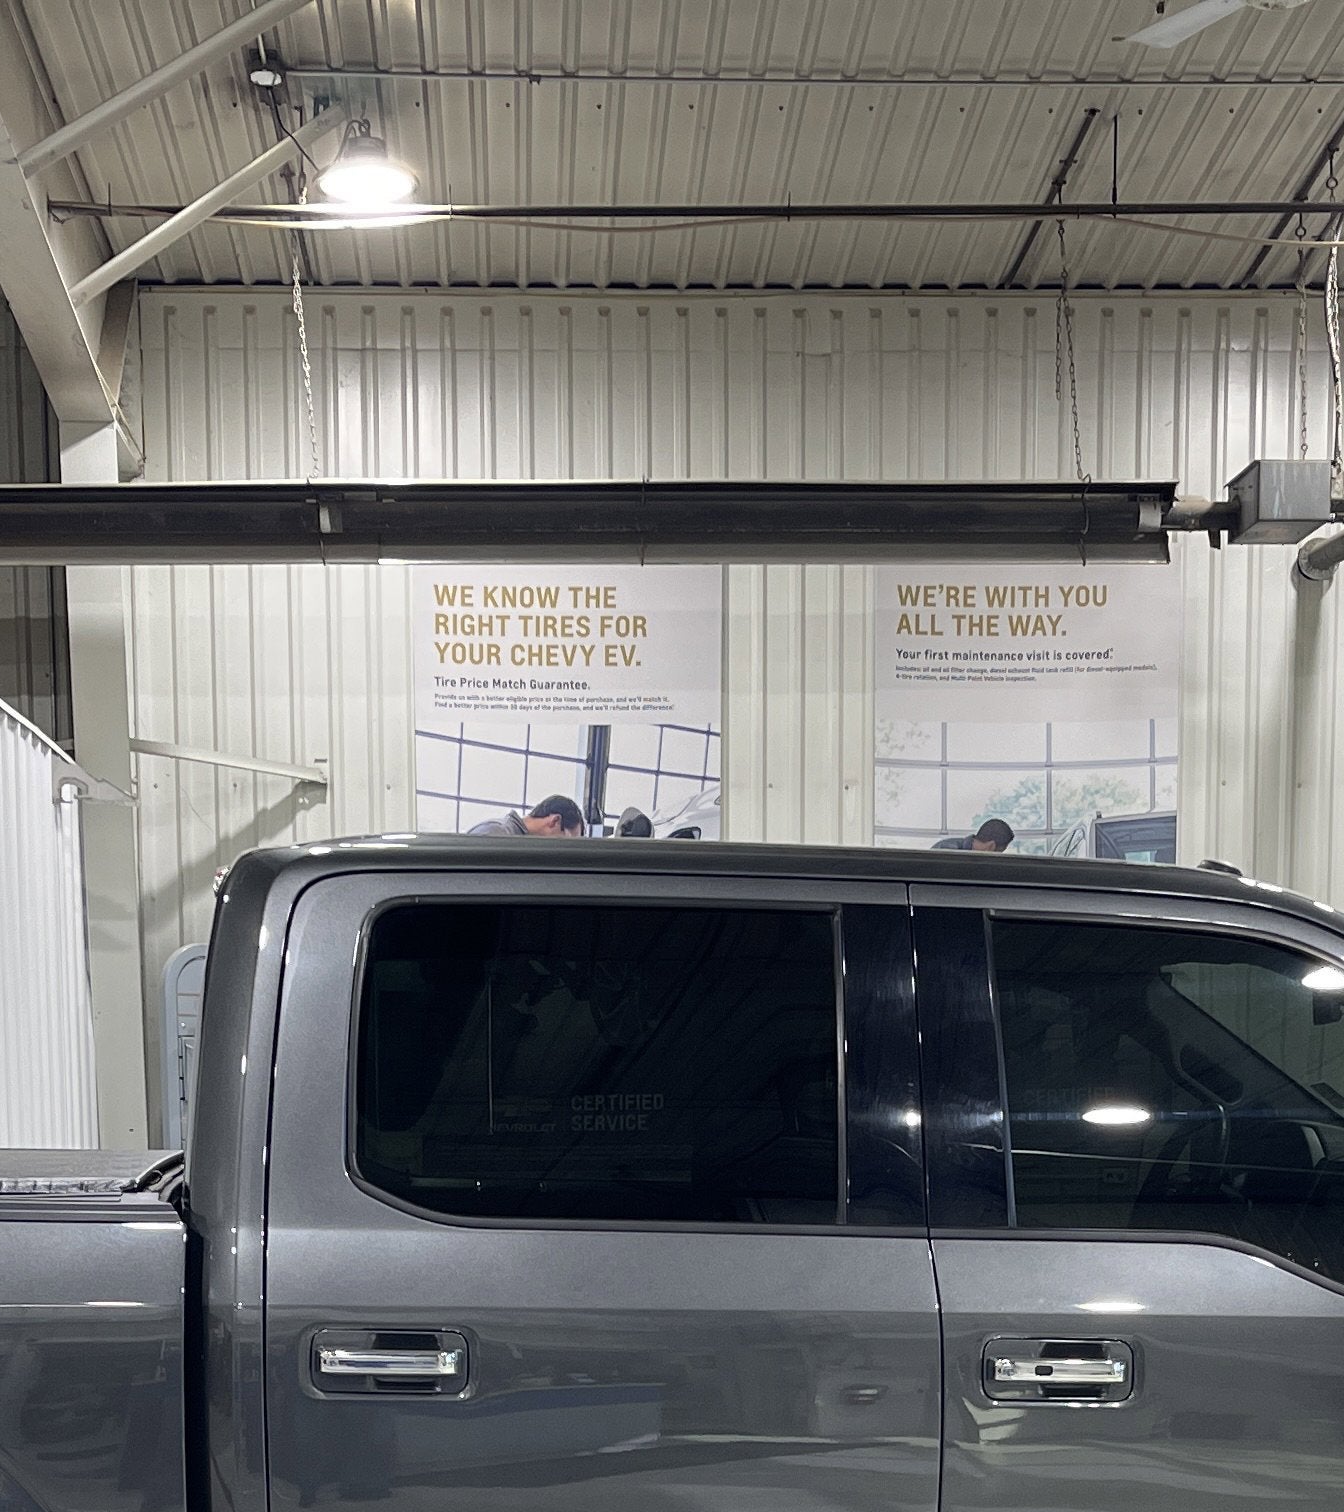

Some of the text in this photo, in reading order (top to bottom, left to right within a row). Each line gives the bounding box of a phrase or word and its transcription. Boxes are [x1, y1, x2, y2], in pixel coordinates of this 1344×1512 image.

[434, 584, 617, 609] WE KNOW THE
[896, 584, 1108, 608] WE'RE WITH YOU
[435, 613, 647, 638] RIGHT TIRES FOR
[896, 613, 1067, 637] ALL THE WAY.
[434, 641, 642, 667] YOUR CHEVY EV.
[895, 648, 921, 660] Your
[924, 649, 949, 661] first
[952, 650, 1024, 662] maintenance
[1026, 649, 1050, 661] visit
[1053, 650, 1062, 660] is
[434, 676, 591, 691] Tire Price Match Guarantee.
[570, 1093, 665, 1112] CERTIFIED
[570, 1114, 649, 1132] SERVICE
